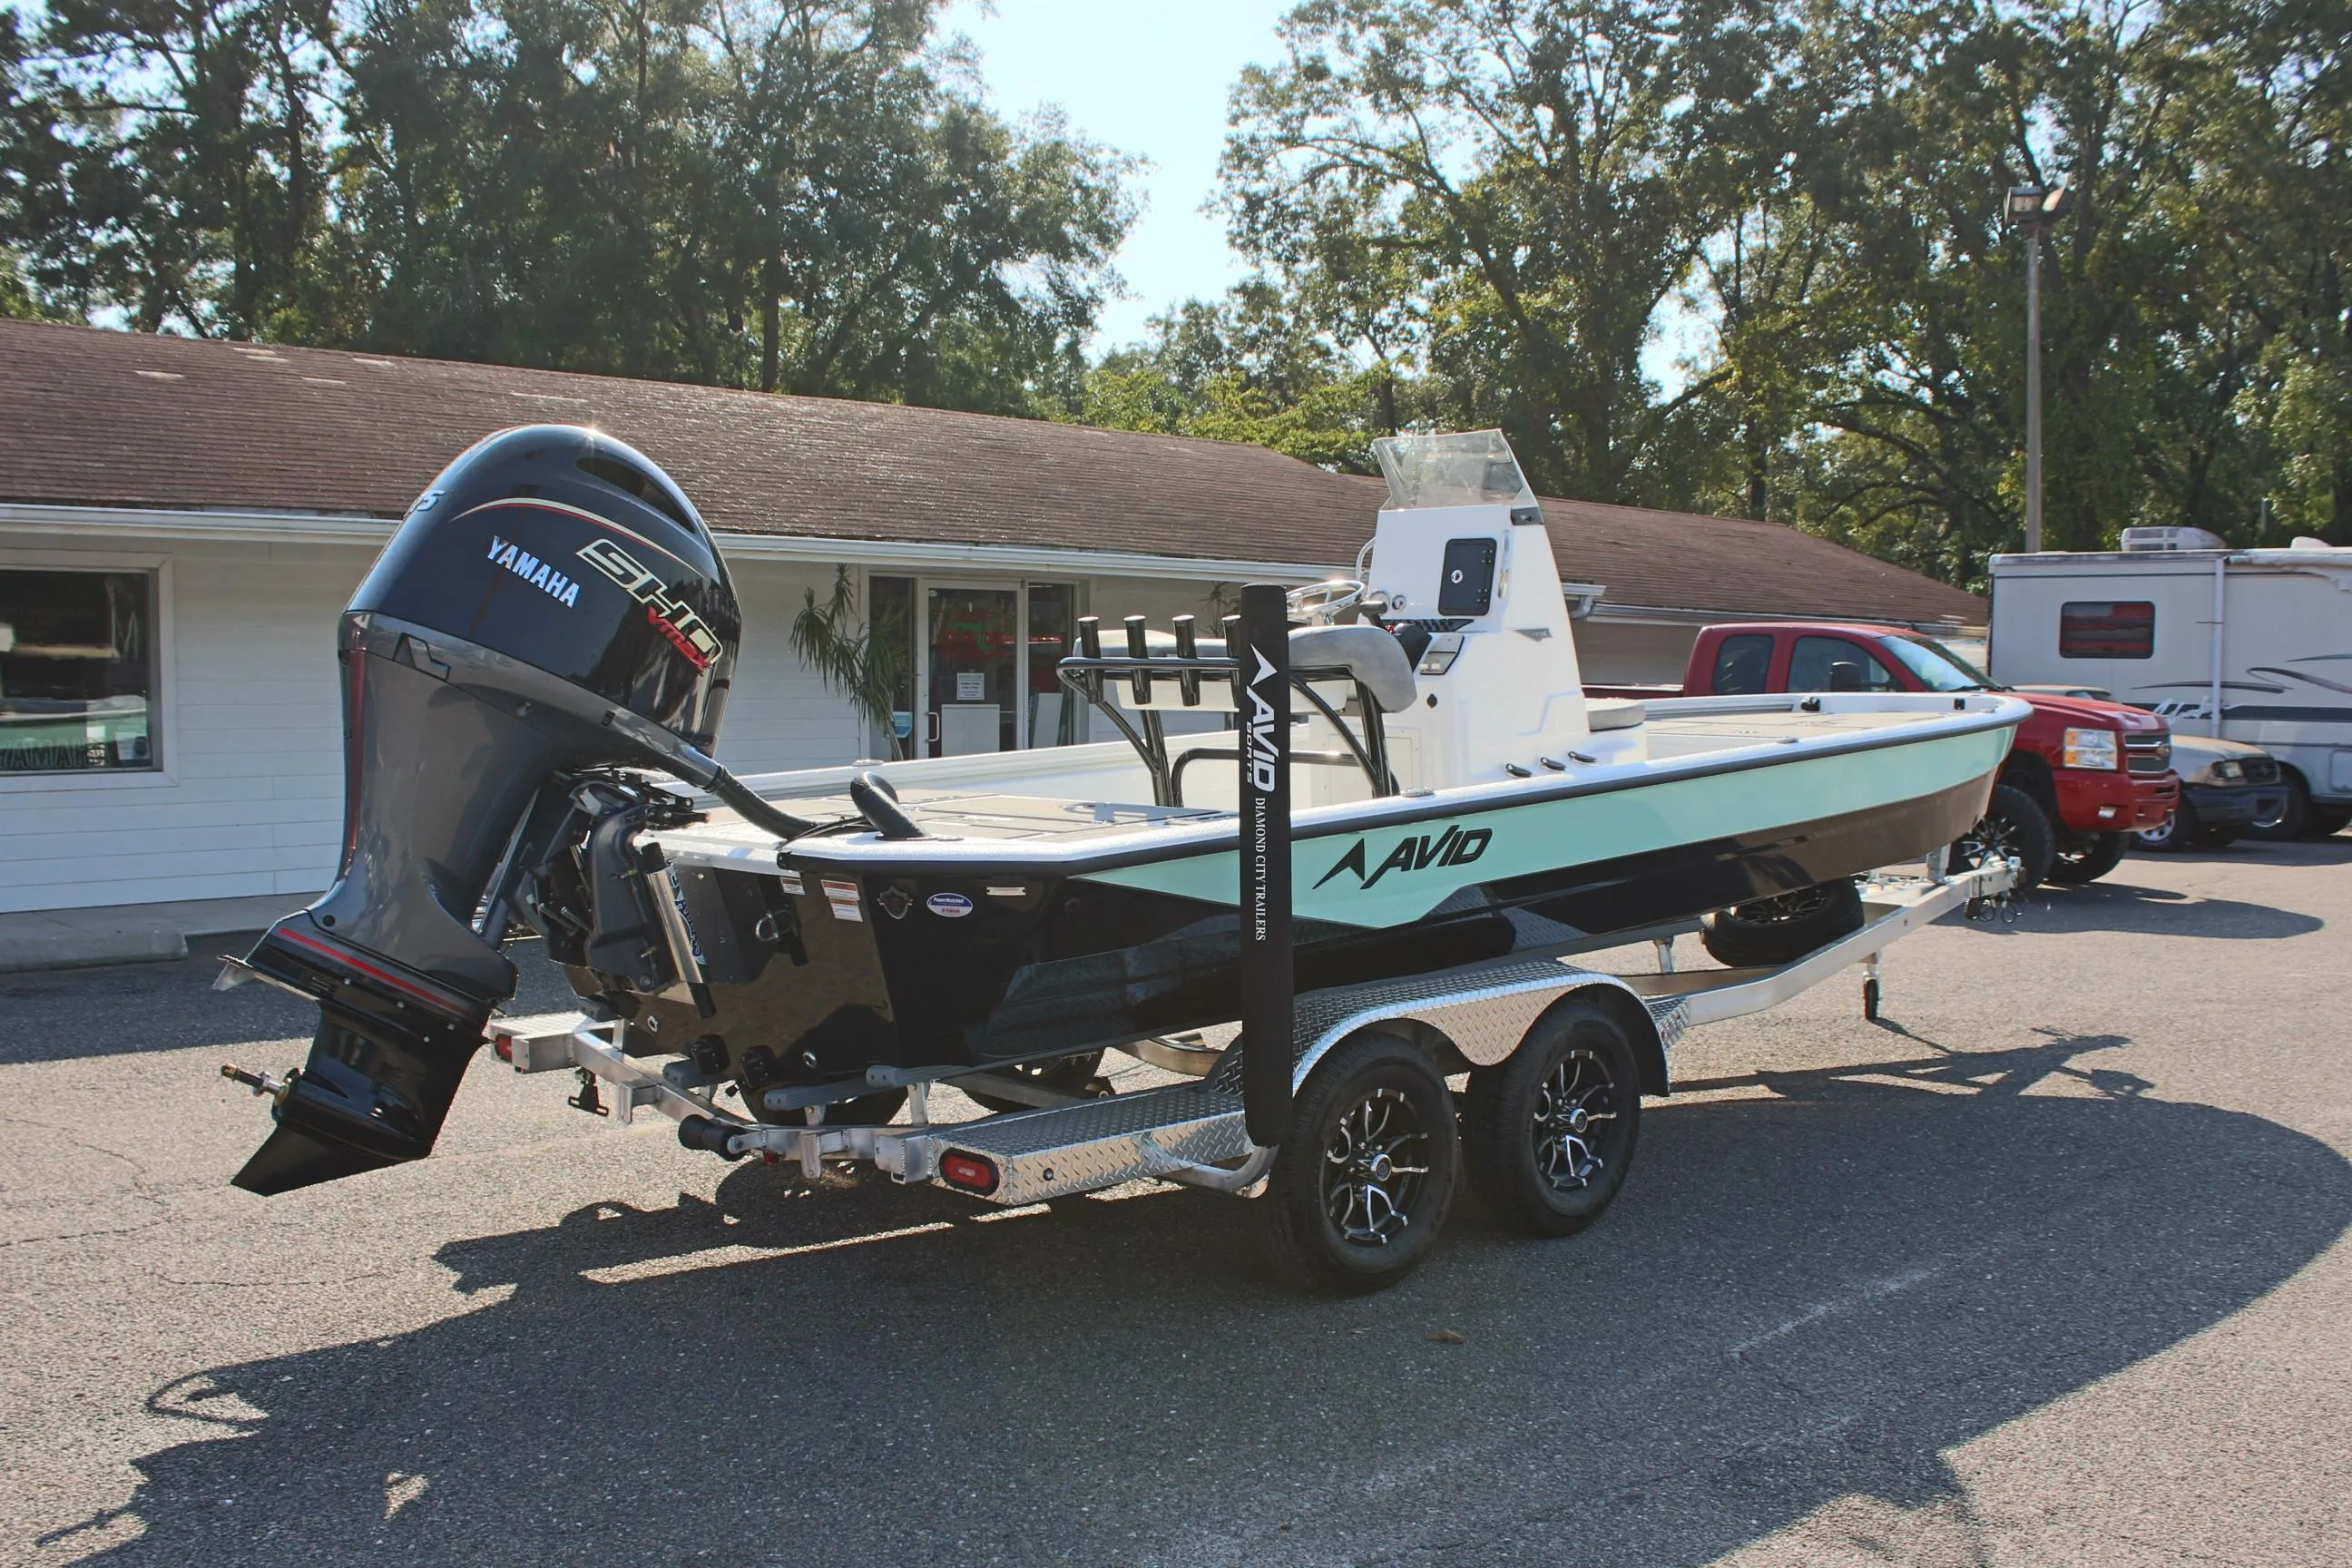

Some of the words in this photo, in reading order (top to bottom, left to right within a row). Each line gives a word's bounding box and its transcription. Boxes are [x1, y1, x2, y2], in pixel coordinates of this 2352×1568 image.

[486, 534, 581, 609] YAMAHA
[574, 538, 723, 665] SHO
[1246, 684, 1279, 792] AVID
[1255, 798, 1266, 853] DIAMOND
[1359, 824, 1493, 890] AVID
[1255, 855, 1266, 883] CITY
[1255, 885, 1266, 941] TRAILERS
